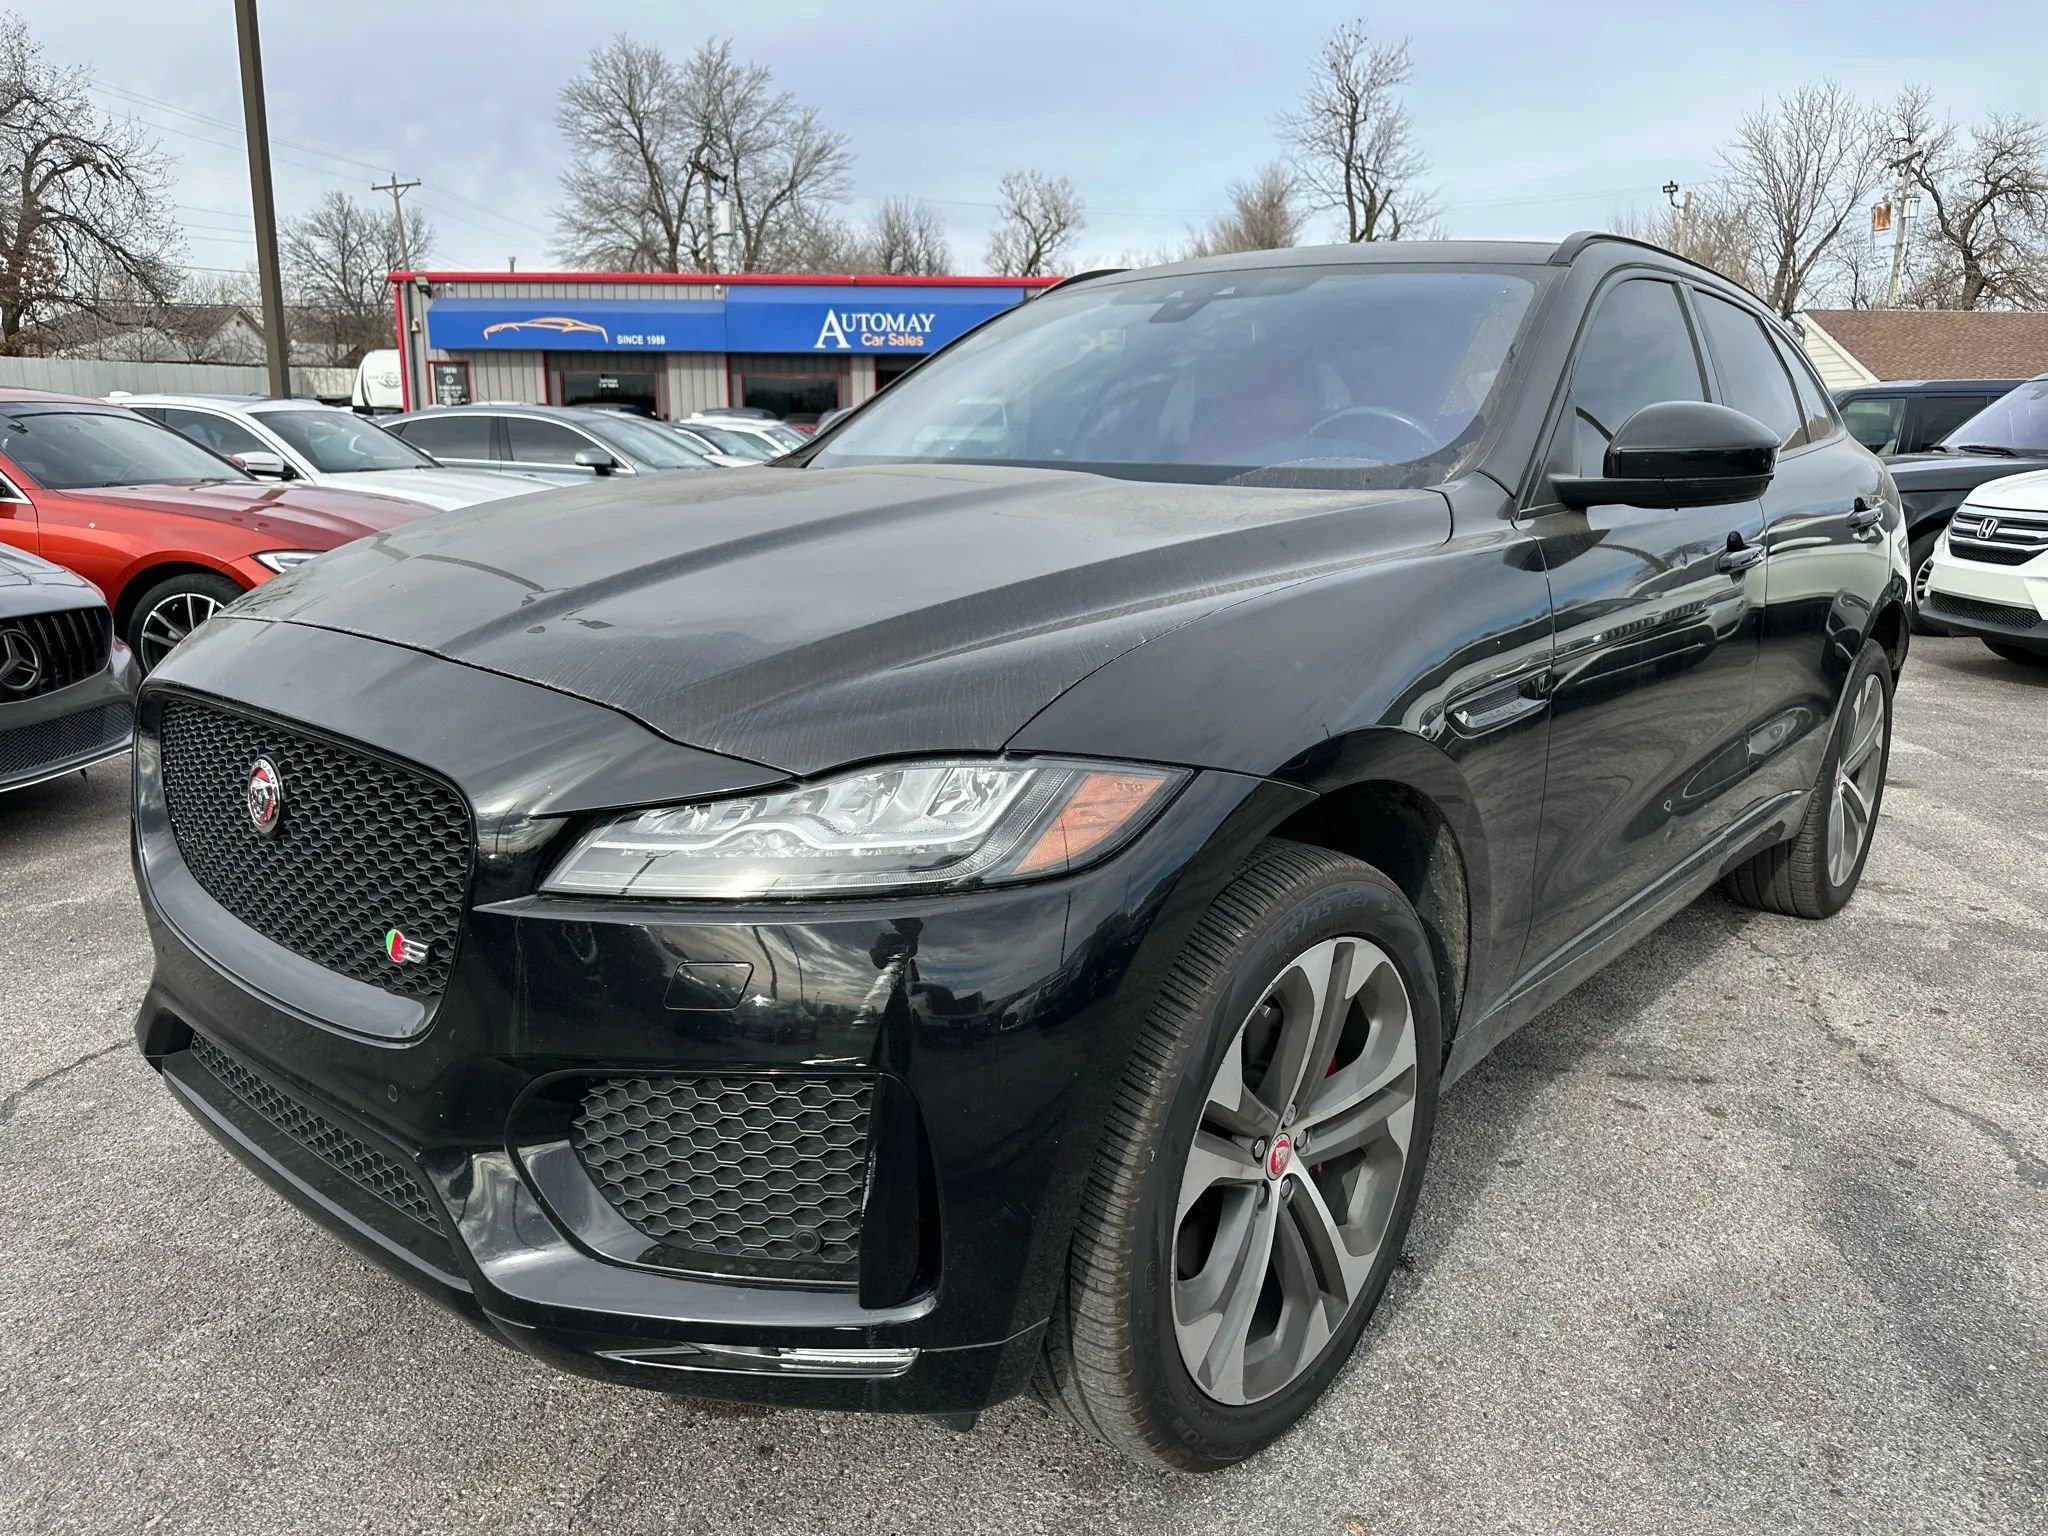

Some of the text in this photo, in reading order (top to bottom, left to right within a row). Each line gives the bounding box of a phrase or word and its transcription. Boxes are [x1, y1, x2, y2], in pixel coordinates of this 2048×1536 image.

[813, 308, 936, 349] AUTOMAY
[617, 335, 666, 345] SINCE 1988
[861, 332, 924, 347] Car Sales
